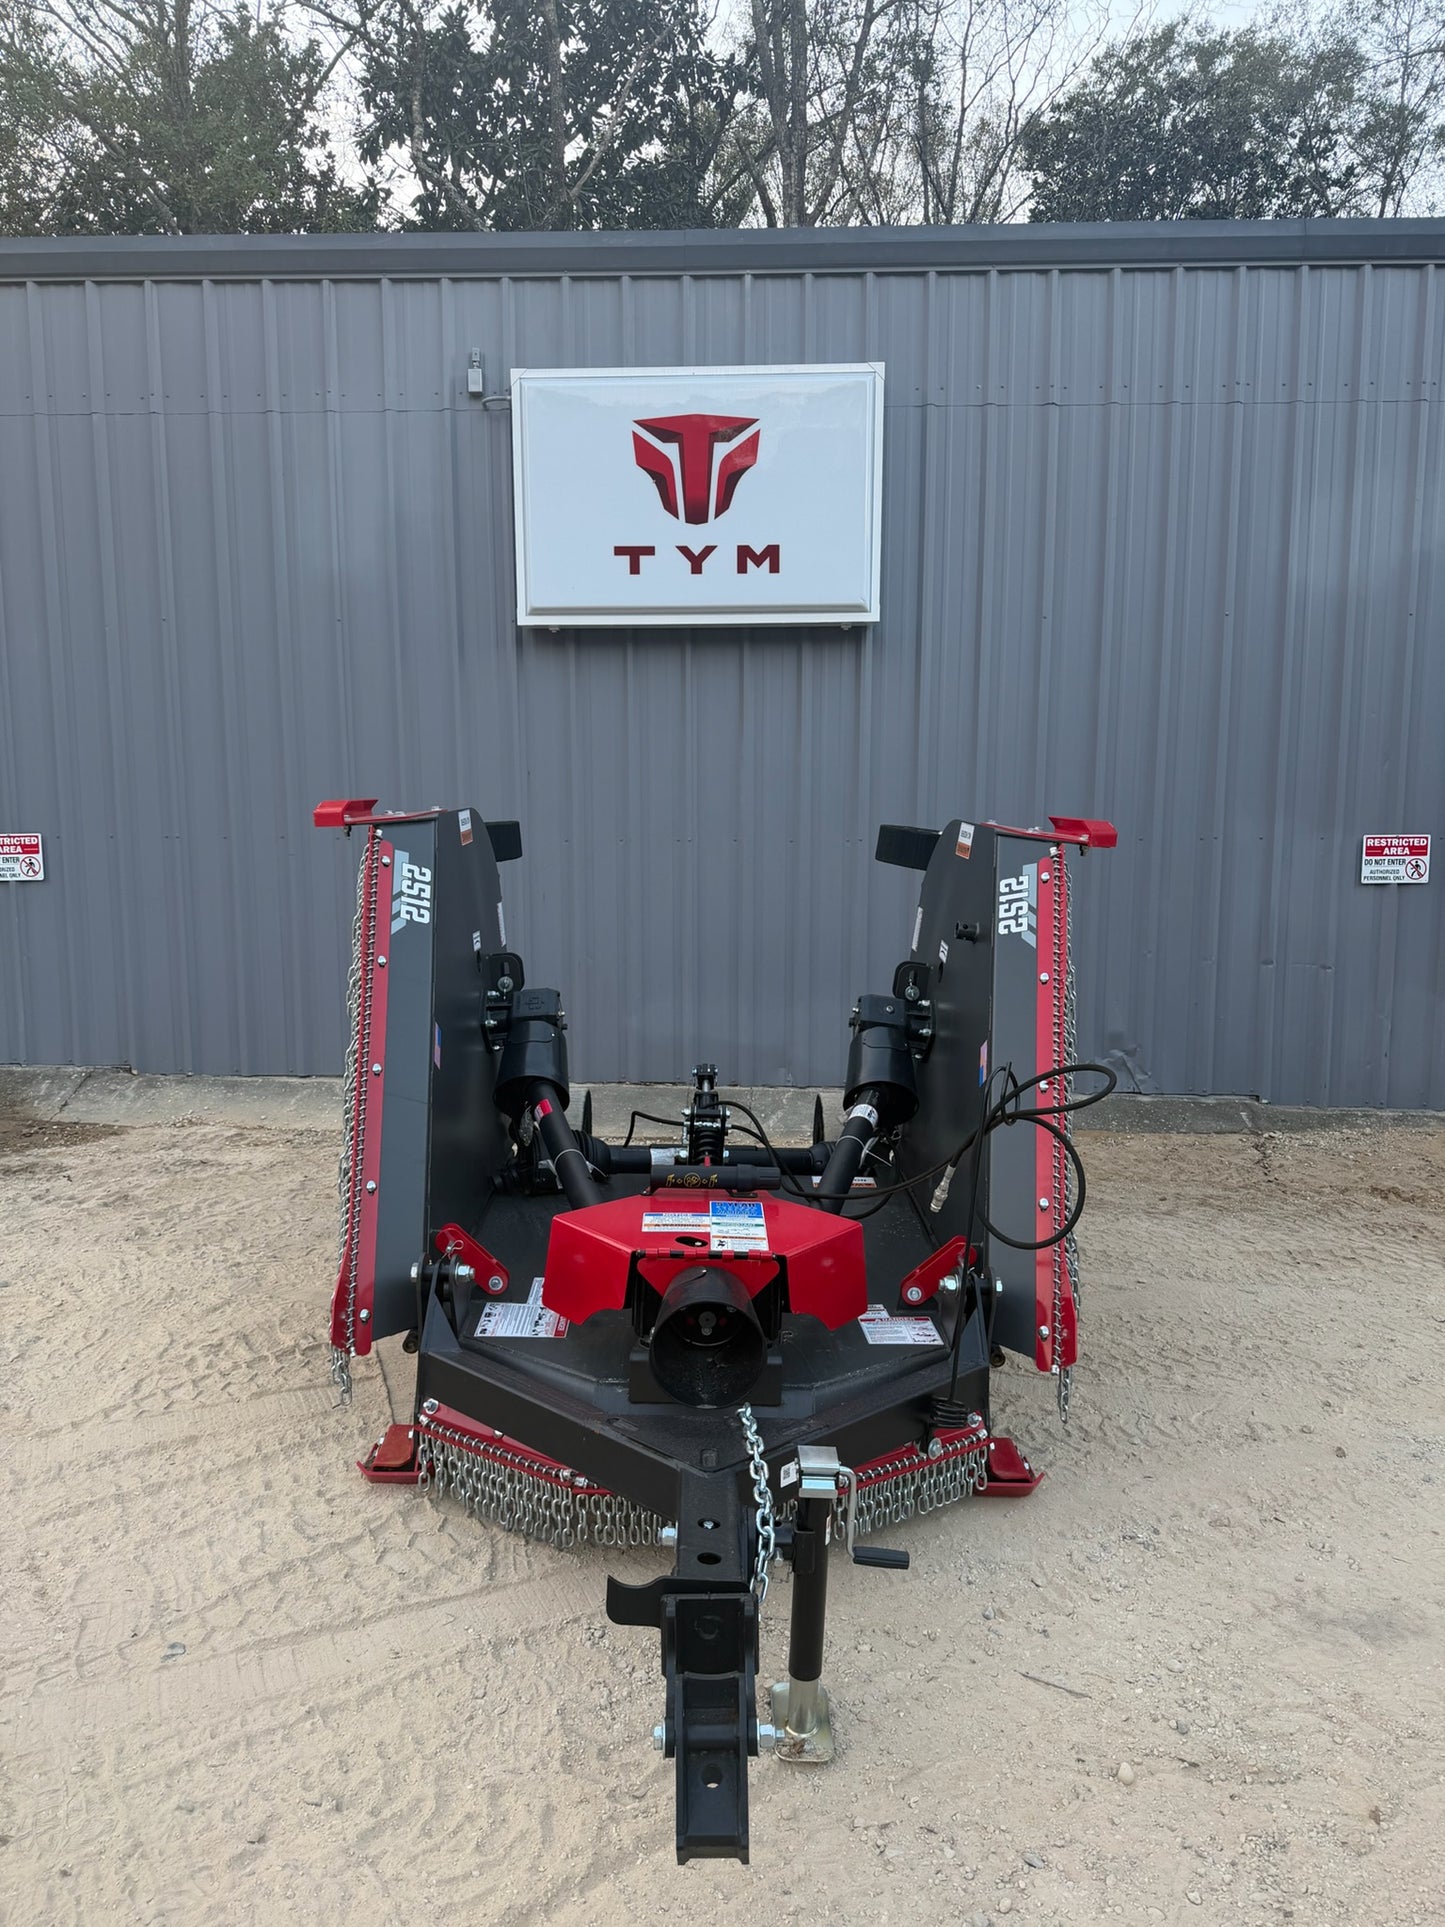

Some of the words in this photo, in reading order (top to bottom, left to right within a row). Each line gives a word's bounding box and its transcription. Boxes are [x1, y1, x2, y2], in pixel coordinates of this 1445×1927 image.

[614, 545, 780, 575] TYM
[1367, 838, 1427, 847] RESTRICTED
[1383, 847, 1410, 855] AREA
[1364, 858, 1373, 866] DO
[1375, 858, 1386, 866] NOT
[1388, 858, 1406, 866] ENTER
[400, 862, 432, 924] 2512
[998, 875, 1029, 935] 2512
